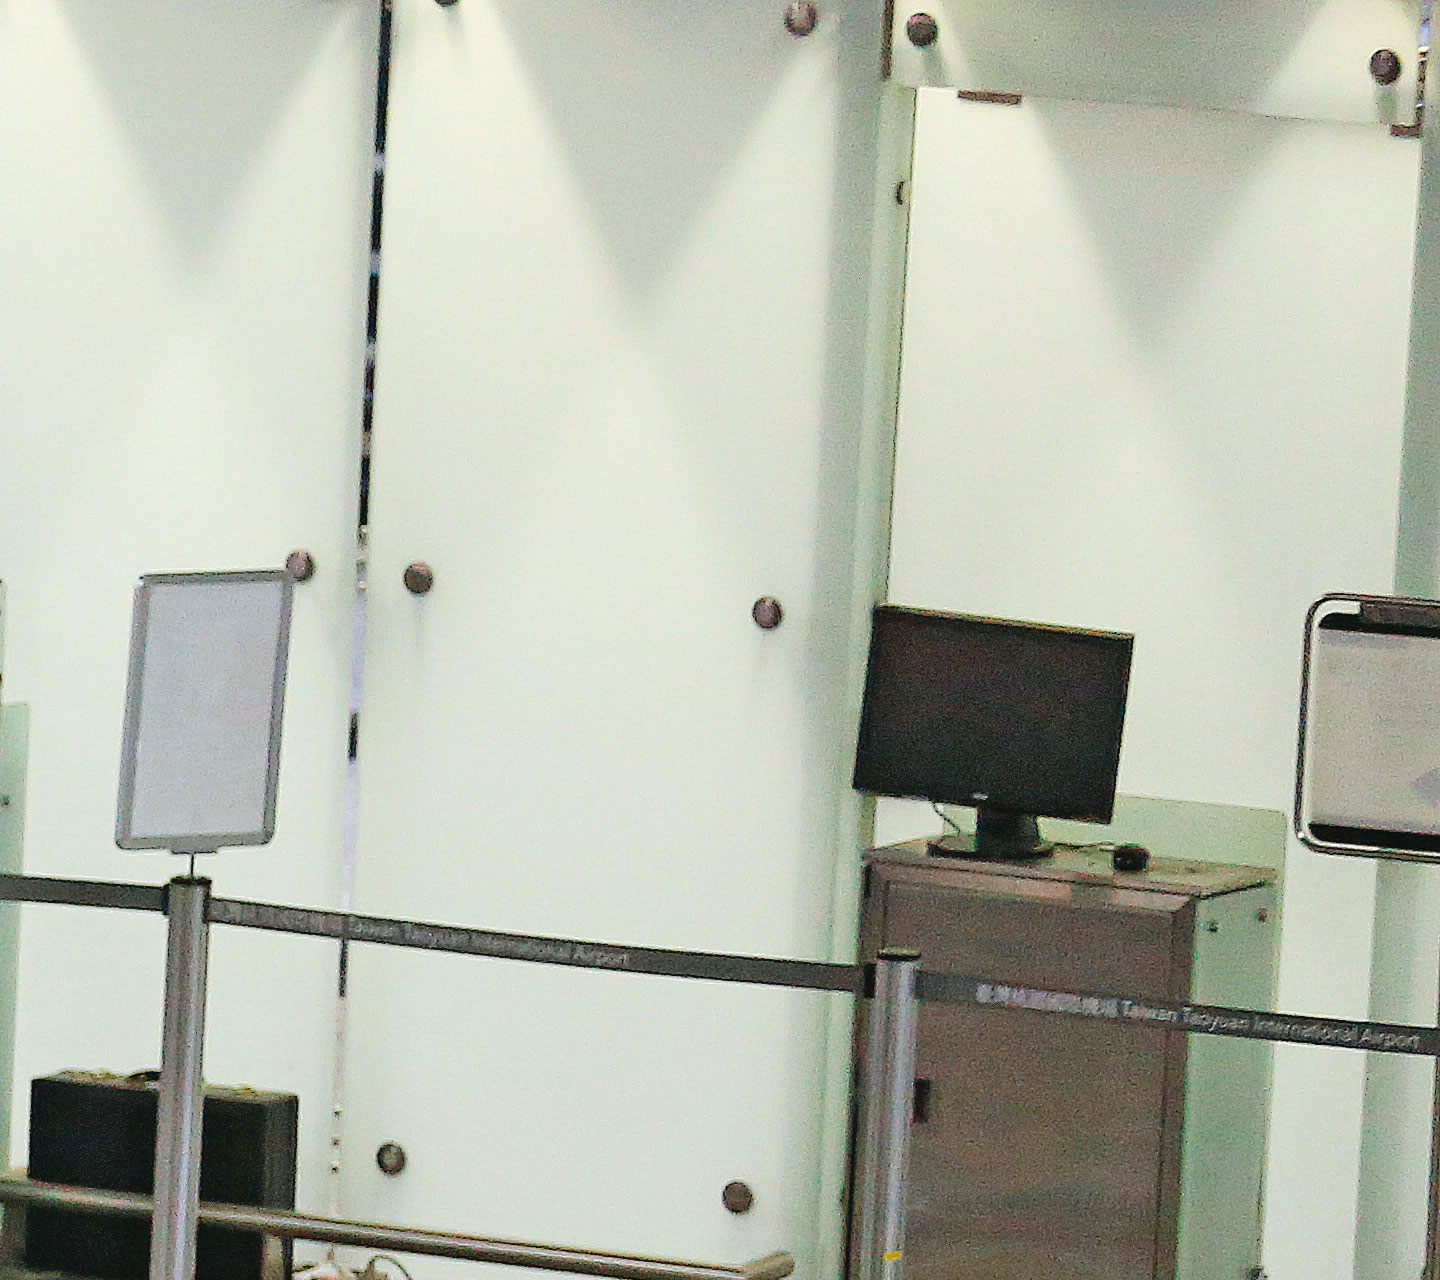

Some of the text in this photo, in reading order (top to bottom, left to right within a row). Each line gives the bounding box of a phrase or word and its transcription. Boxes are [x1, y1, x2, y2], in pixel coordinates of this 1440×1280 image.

[572, 942, 630, 967] Airport
[1252, 1013, 1358, 1042] International
[1360, 1026, 1420, 1051] Airport
